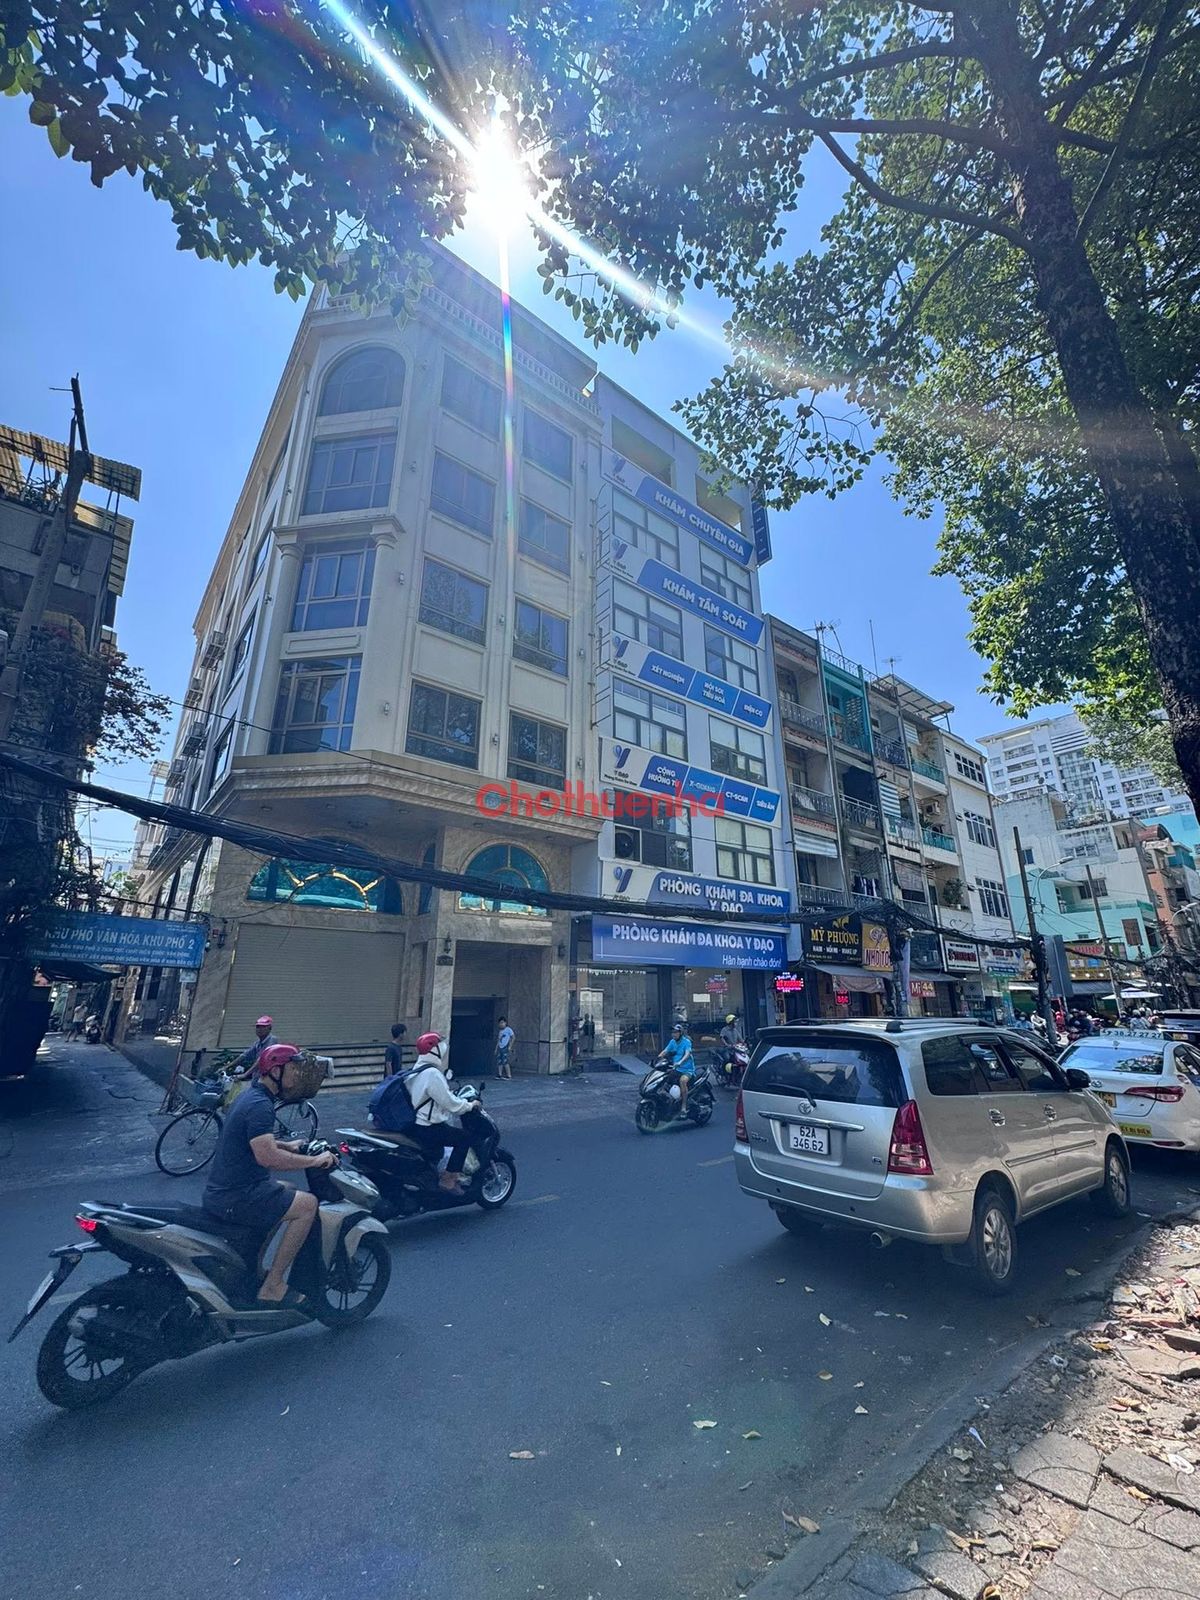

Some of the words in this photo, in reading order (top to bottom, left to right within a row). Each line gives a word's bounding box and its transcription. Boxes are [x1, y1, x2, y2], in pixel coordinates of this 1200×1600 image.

[655, 491, 686, 517] KHÁM
[689, 514, 728, 545] CHUYÊN
[728, 541, 745, 556] GIA
[663, 578, 695, 603] KHÁM
[722, 610, 748, 631] SOÁT
[660, 877, 701, 896] PHÒNG
[705, 882, 736, 902] KHÁM
[739, 891, 754, 904] ĐA
[757, 893, 783, 908] KHOA
[708, 900, 717, 911] Y
[142, 934, 165, 947] KHU
[165, 935, 187, 949] PHỐ
[188, 938, 195, 950] 2
[612, 923, 659, 942] PHÒNG
[662, 927, 696, 945] KHÁM
[697, 933, 713, 946] ĐA
[715, 934, 743, 948] KHOA
[745, 937, 752, 949] Y
[754, 937, 774, 954] ĐẠO
[827, 931, 859, 947] PHƯỢNG
[800, 1126, 817, 1139] 62A
[793, 1137, 824, 1152] 346.62
